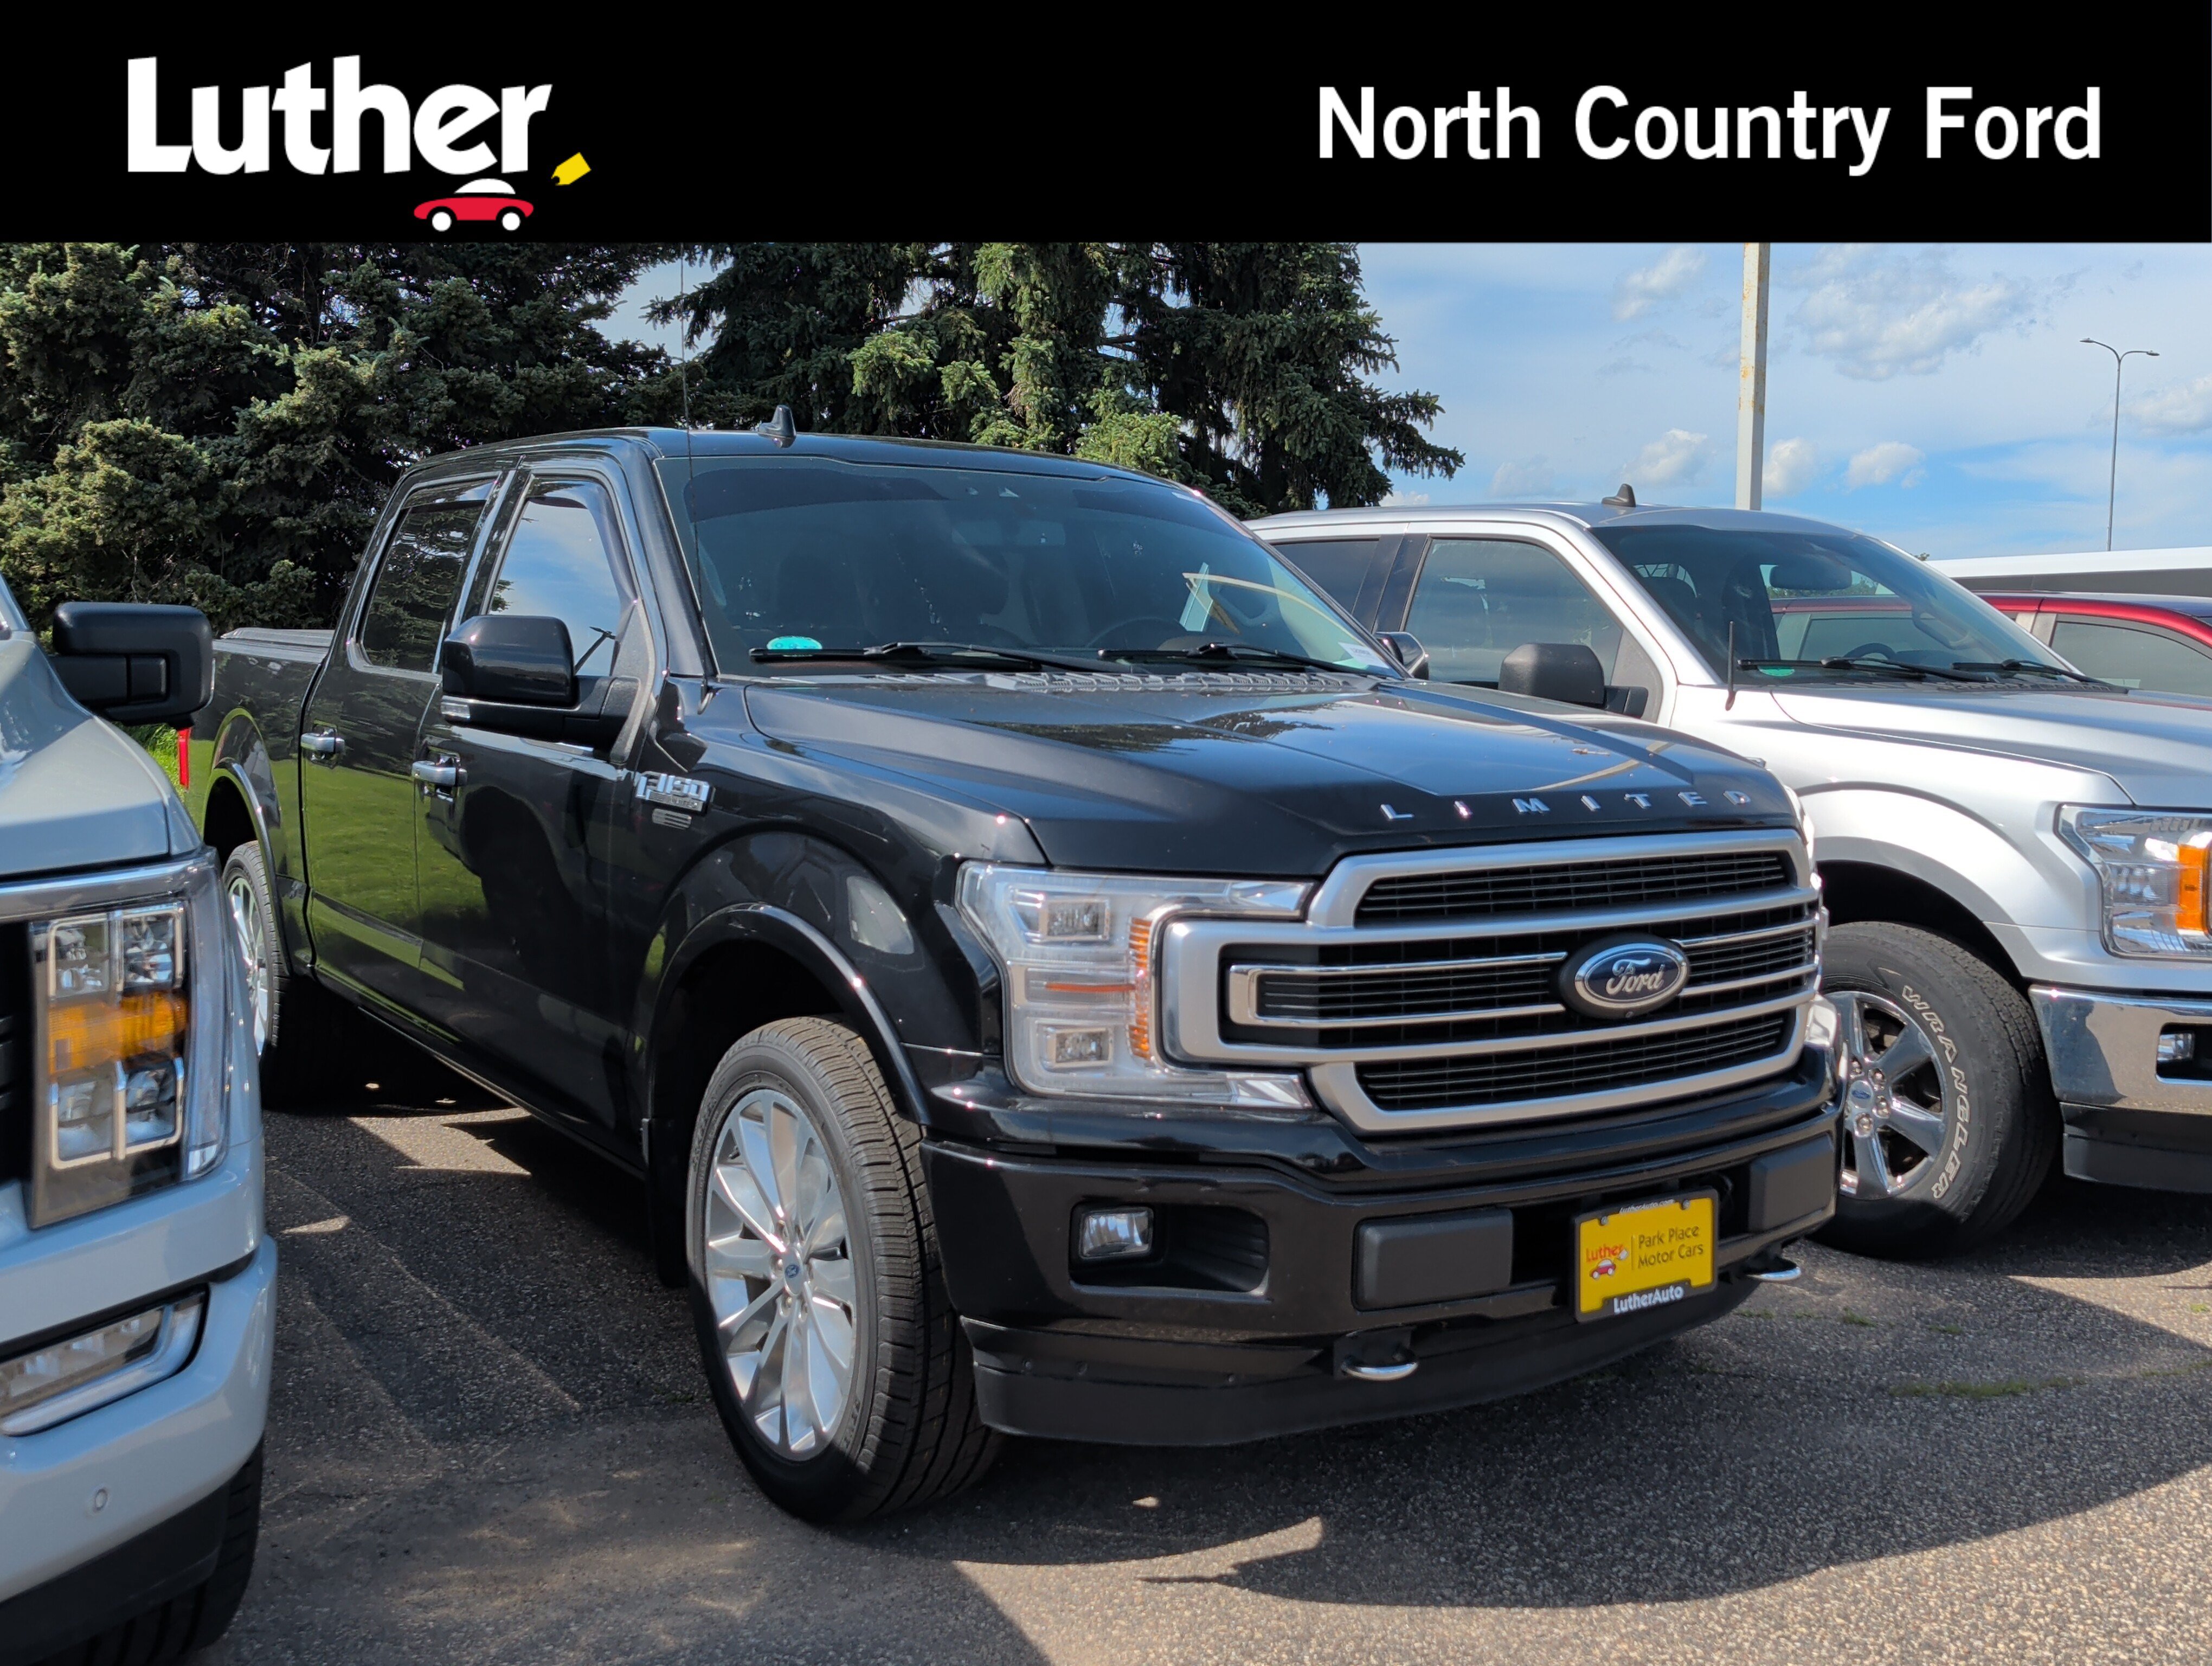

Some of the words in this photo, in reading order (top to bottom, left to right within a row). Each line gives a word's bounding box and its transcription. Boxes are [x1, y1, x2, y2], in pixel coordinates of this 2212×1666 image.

[1380, 790, 1751, 820] LIMITED
[1606, 958, 1666, 995] Ford
[1902, 985, 1971, 1199] WRANGLER
[1638, 1231, 1664, 1248] Park
[1668, 1226, 1699, 1242] Place
[1586, 1244, 1623, 1263] Luther
[1637, 1249, 1674, 1270] Motor
[1678, 1244, 1704, 1259] Cars
[1613, 1285, 1684, 1315] LutherAuto
